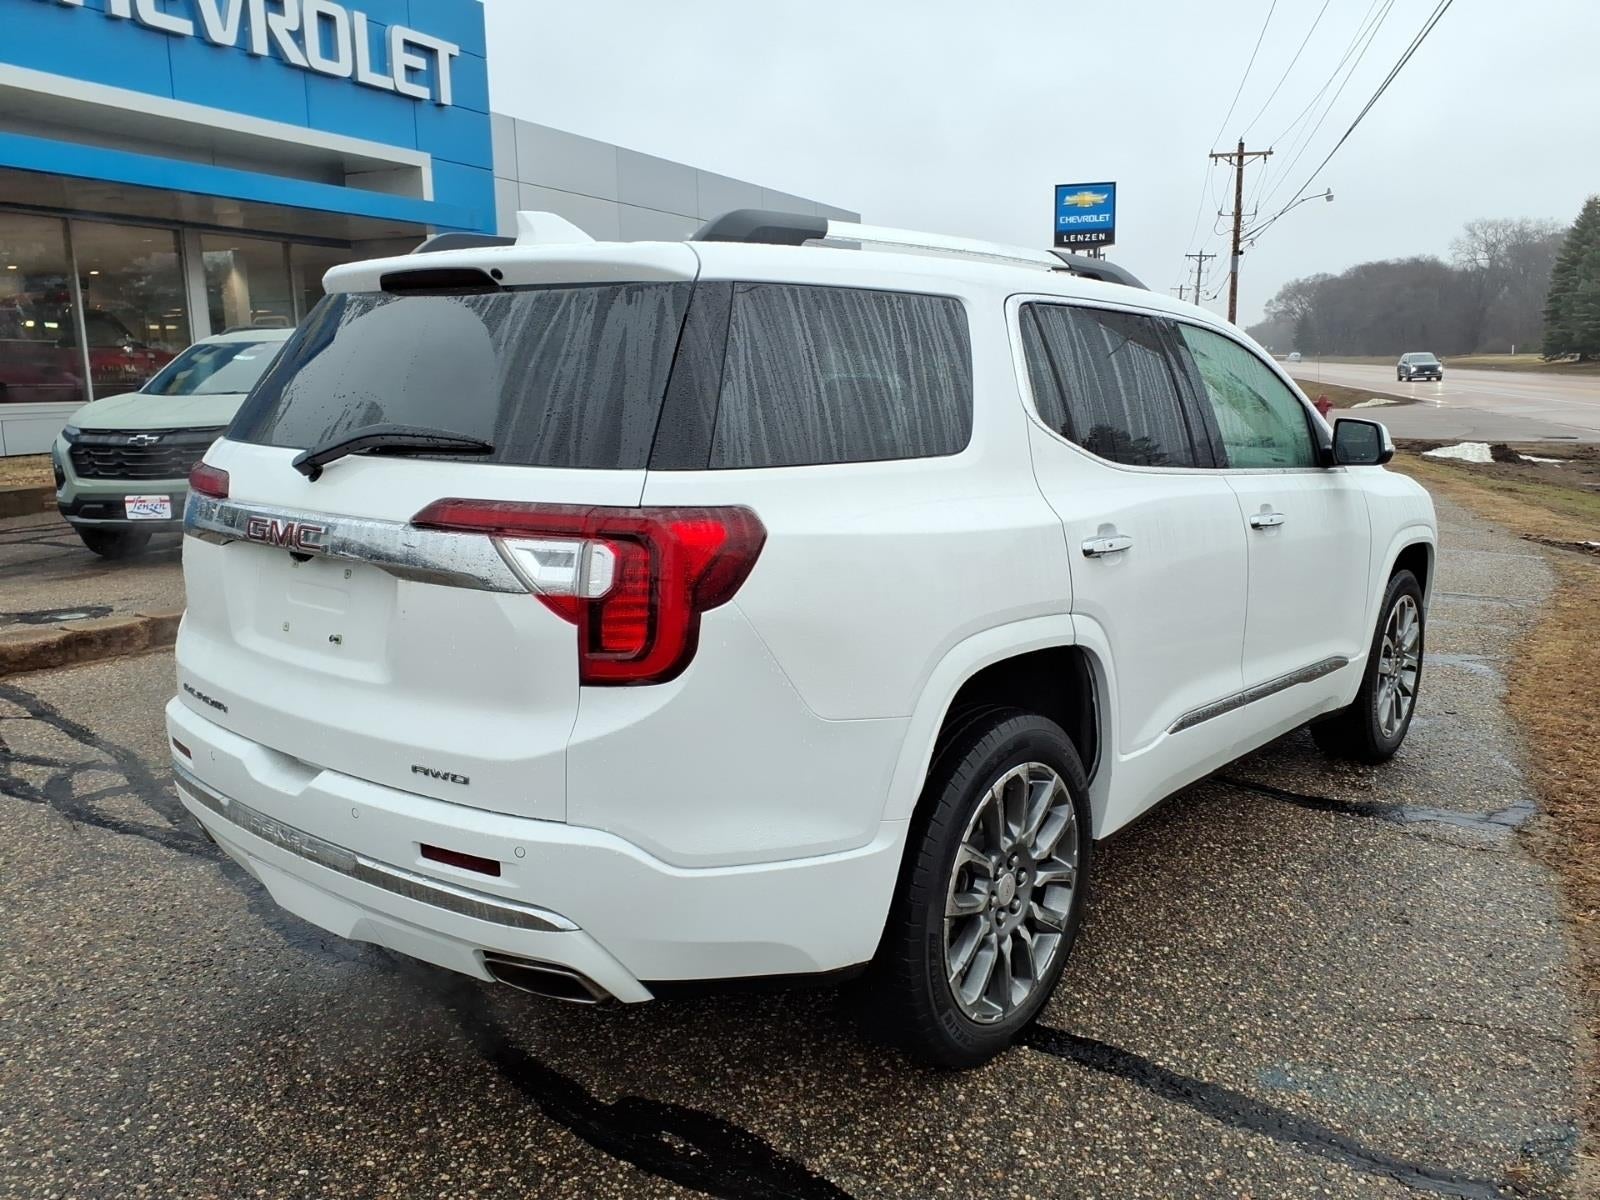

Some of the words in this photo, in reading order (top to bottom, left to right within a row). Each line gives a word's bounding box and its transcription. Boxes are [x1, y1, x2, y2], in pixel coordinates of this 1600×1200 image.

[1060, 214, 1110, 223] CHEVROLET
[1064, 232, 1106, 242] LENZEN
[247, 516, 327, 551] GMC
[410, 764, 470, 785] AWD
